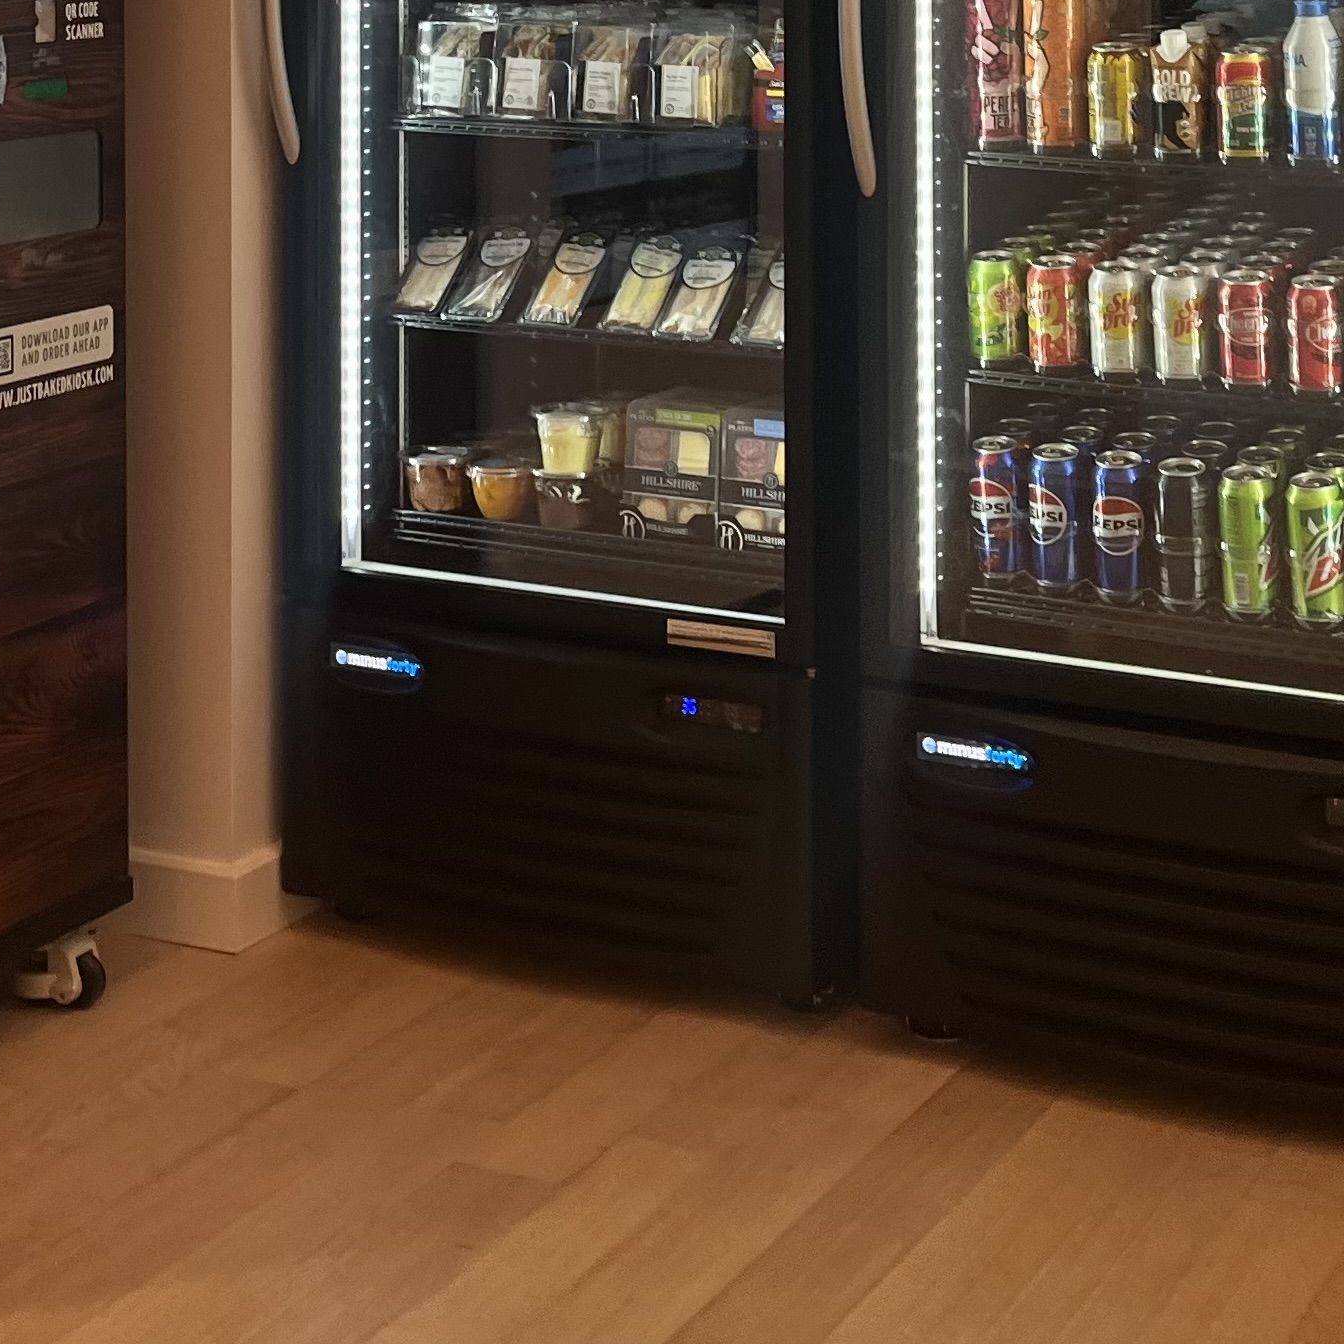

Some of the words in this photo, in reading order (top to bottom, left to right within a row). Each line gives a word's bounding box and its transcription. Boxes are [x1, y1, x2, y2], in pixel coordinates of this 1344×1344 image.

[65, 2, 77, 21] QR
[78, 1, 99, 19] CODE
[65, 22, 104, 42] SCANNER
[21, 325, 70, 350] DOWNLOAD
[72, 320, 90, 338] OUR
[92, 316, 109, 333] APP
[21, 349, 40, 367] AND
[42, 343, 70, 362] ORDER
[72, 335, 101, 354] AHEAD
[641, 474, 699, 492] HILLSHIRE
[1095, 517, 1142, 531] PEPSI
[347, 651, 420, 678] minusforty
[936, 740, 1027, 769] minusforty
